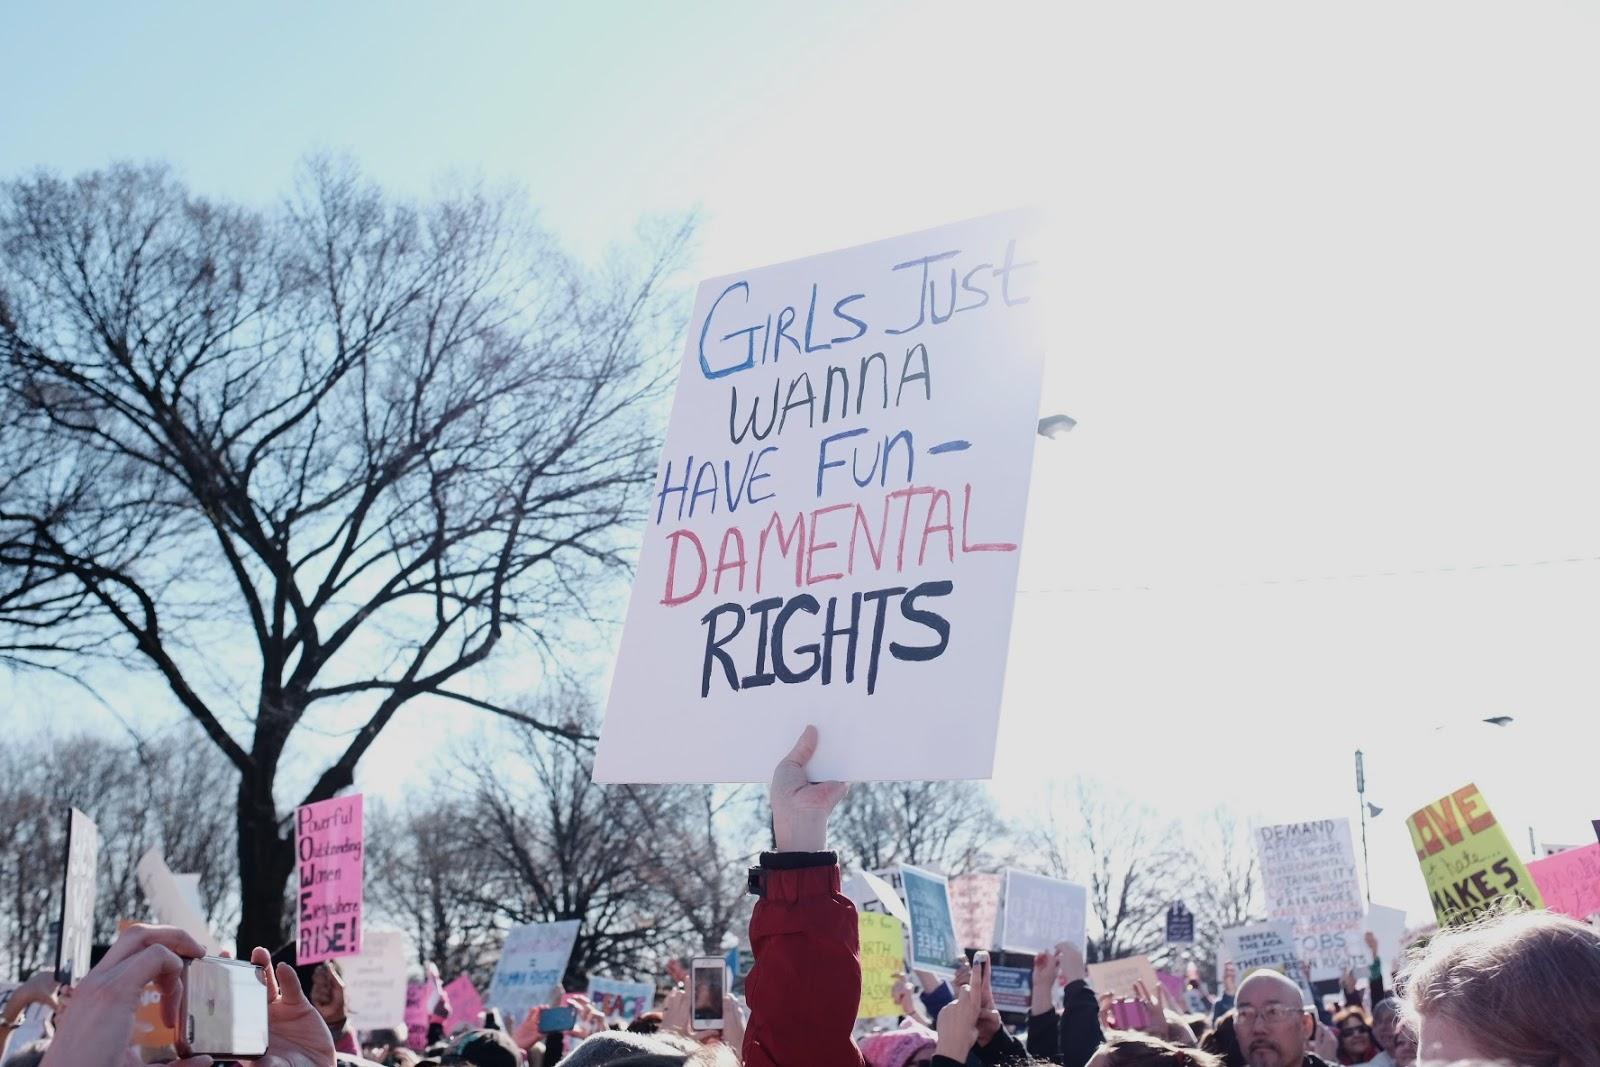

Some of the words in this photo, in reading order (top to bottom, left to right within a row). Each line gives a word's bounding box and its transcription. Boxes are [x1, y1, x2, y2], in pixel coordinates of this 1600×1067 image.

[699, 280, 868, 381] GIRLS
[656, 446, 780, 525] HAVE
[659, 483, 1018, 607] DAMENTAL
[700, 580, 954, 698] RIGHTS
[1260, 819, 1335, 842] DEMAND
[300, 863, 342, 889] Women
[300, 916, 357, 959] RISE!
[1262, 938, 1284, 948] ACA
[1293, 931, 1346, 953] OBS
[592, 990, 647, 1019] PEACE
